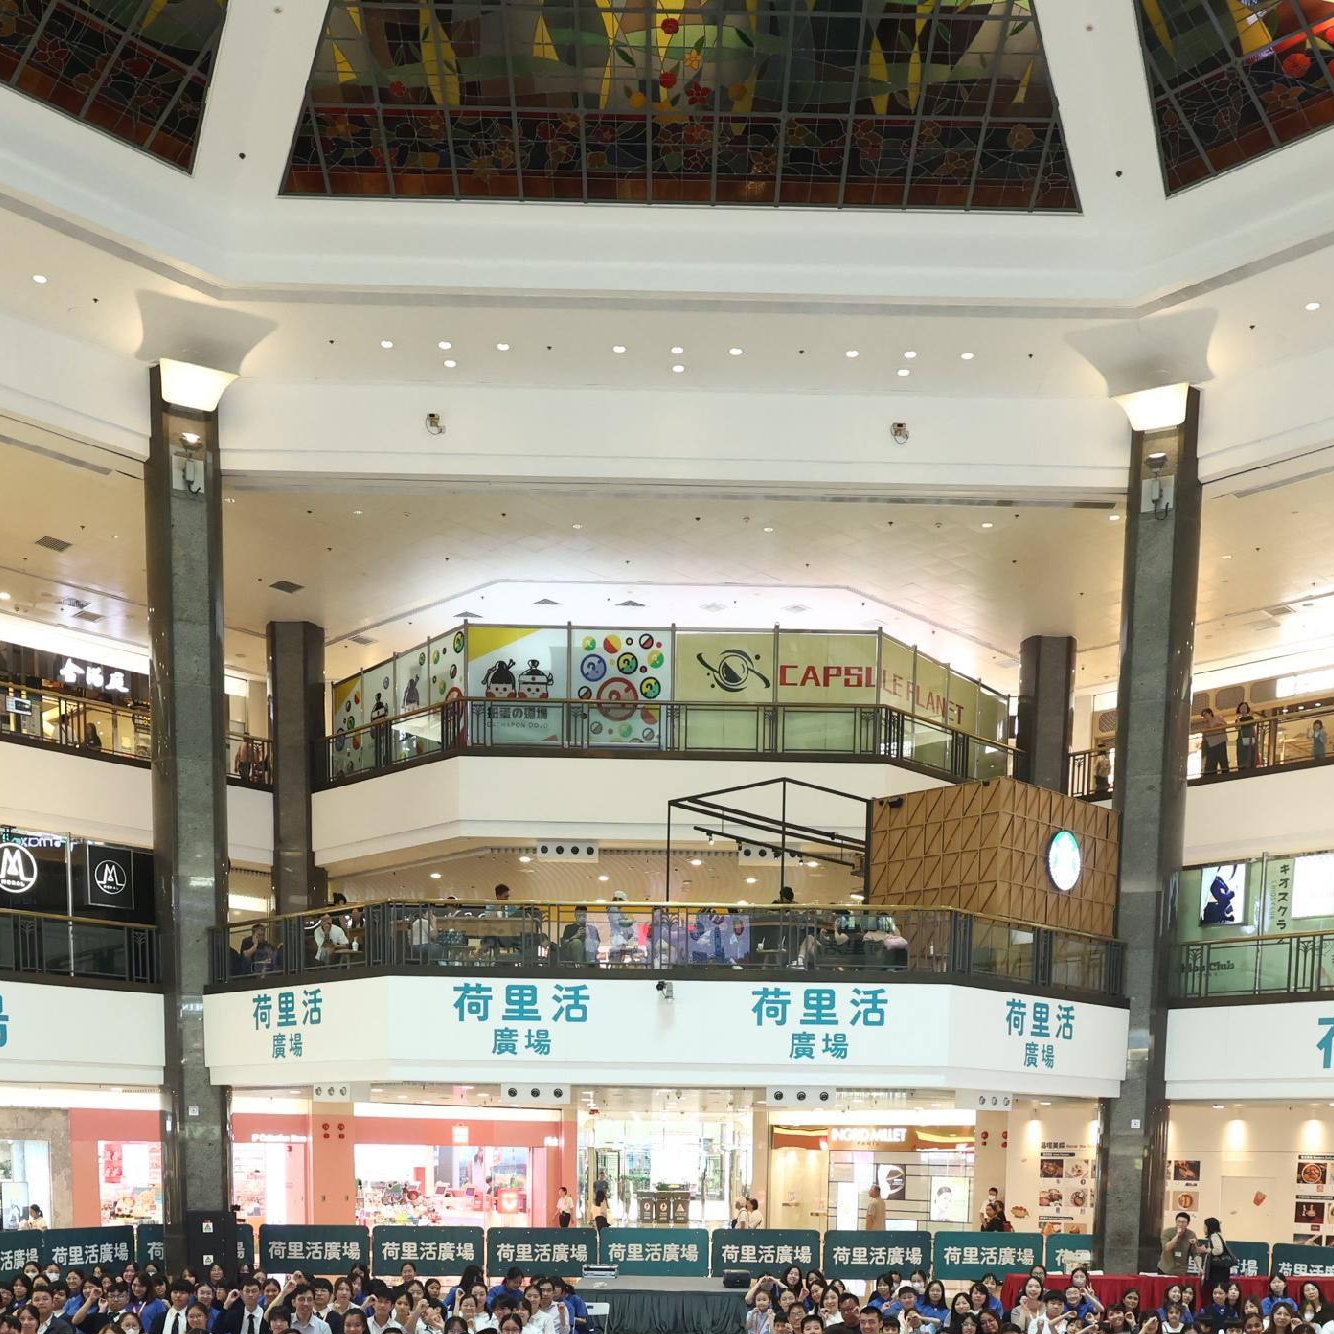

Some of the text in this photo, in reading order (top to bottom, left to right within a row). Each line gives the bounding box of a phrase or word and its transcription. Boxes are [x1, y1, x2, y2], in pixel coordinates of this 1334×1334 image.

[1276, 864, 1291, 944] キオスクラ
[251, 989, 323, 1029] 荷里活
[454, 984, 589, 1022] 荷里活
[753, 988, 887, 1026] 荷里活
[1005, 999, 1075, 1040] 荷里活
[272, 1033, 304, 1059] 廣場
[494, 1028, 550, 1054] 廣場
[792, 1032, 847, 1059] 廣場
[1023, 1042, 1055, 1069] 廣場
[51, 1242, 130, 1265] 荷里活廣場
[268, 1241, 361, 1261] 荷里活廣場
[381, 1241, 475, 1261] 荷里活廣場
[496, 1243, 588, 1263] 荷里活廣場
[608, 1243, 700, 1263] 荷里活廣場
[721, 1243, 813, 1265] 荷里活廣場
[832, 1246, 923, 1266] 荷里活廣場
[943, 1246, 1035, 1266] 荷里活廣場
